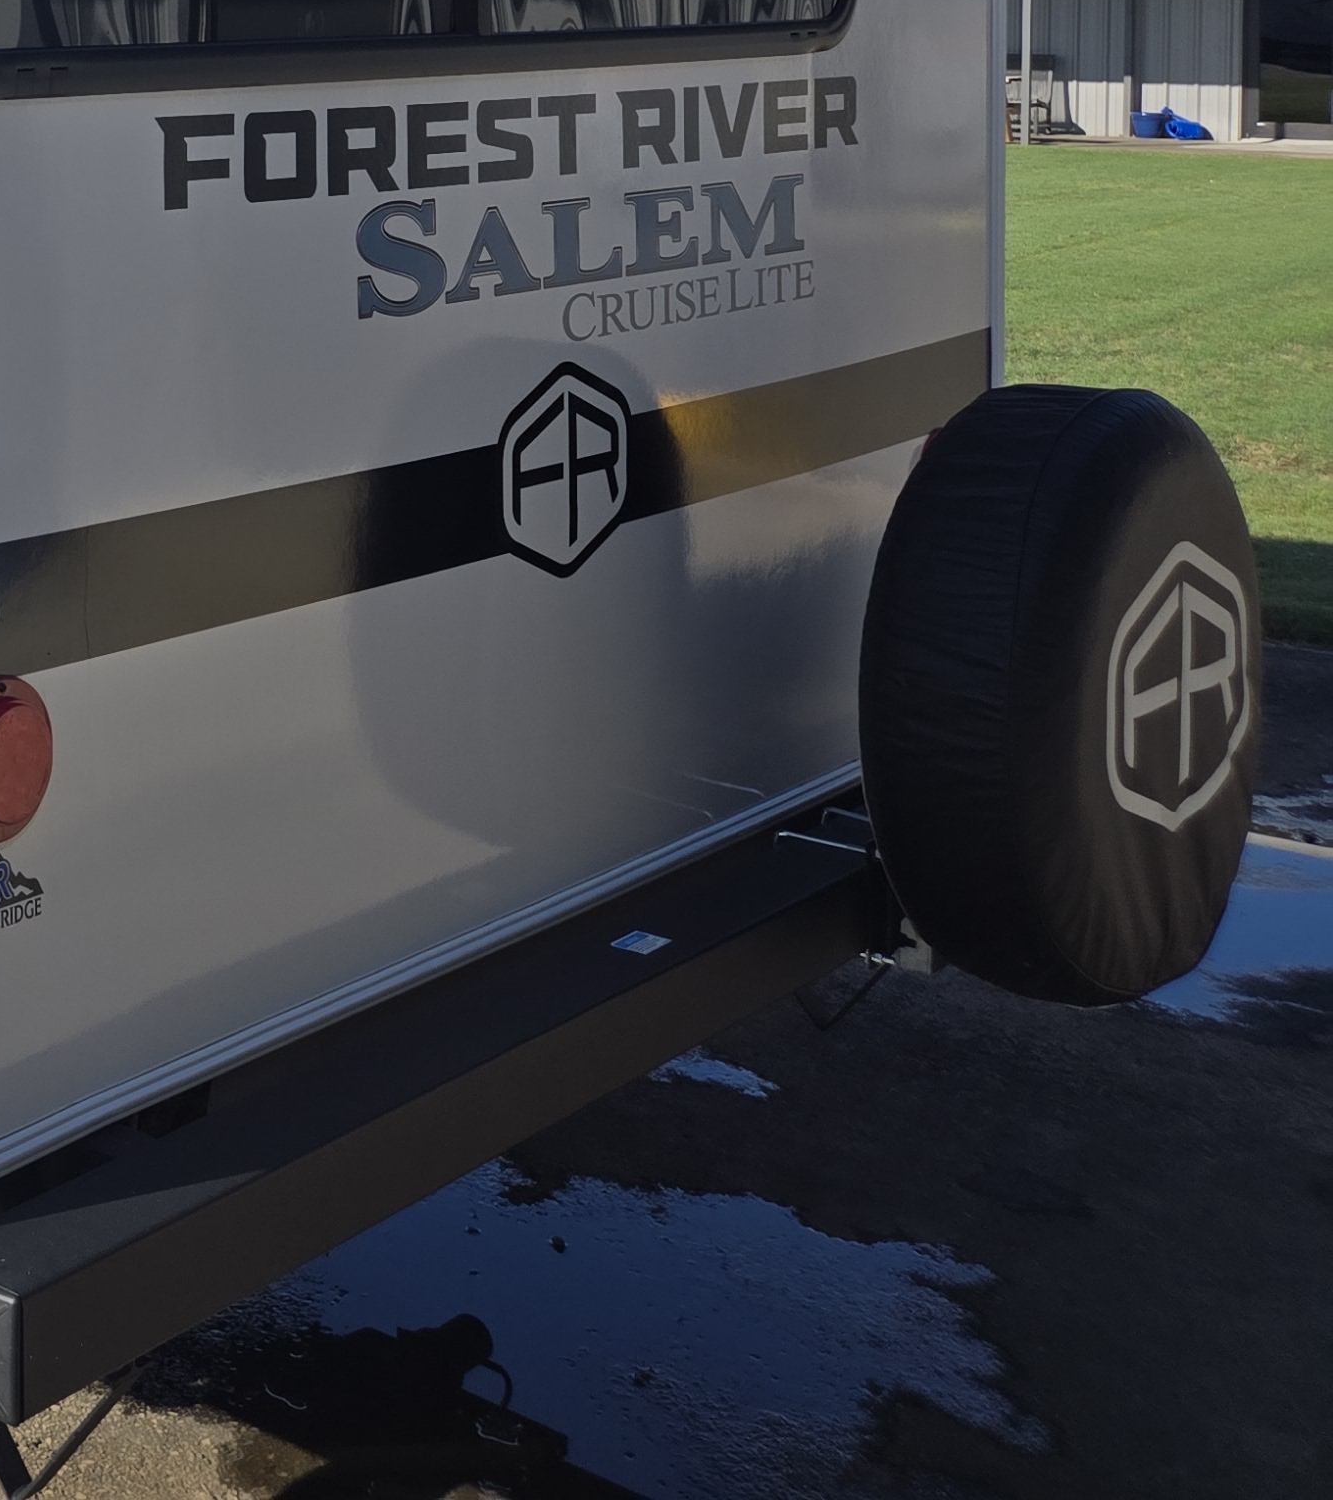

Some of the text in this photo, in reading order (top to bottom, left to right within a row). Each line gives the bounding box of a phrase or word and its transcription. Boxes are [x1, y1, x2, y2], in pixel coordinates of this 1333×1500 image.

[155, 75, 859, 211] FOREST RIVER
[355, 173, 805, 320] SALEM
[0, 896, 43, 929] RIDGE
